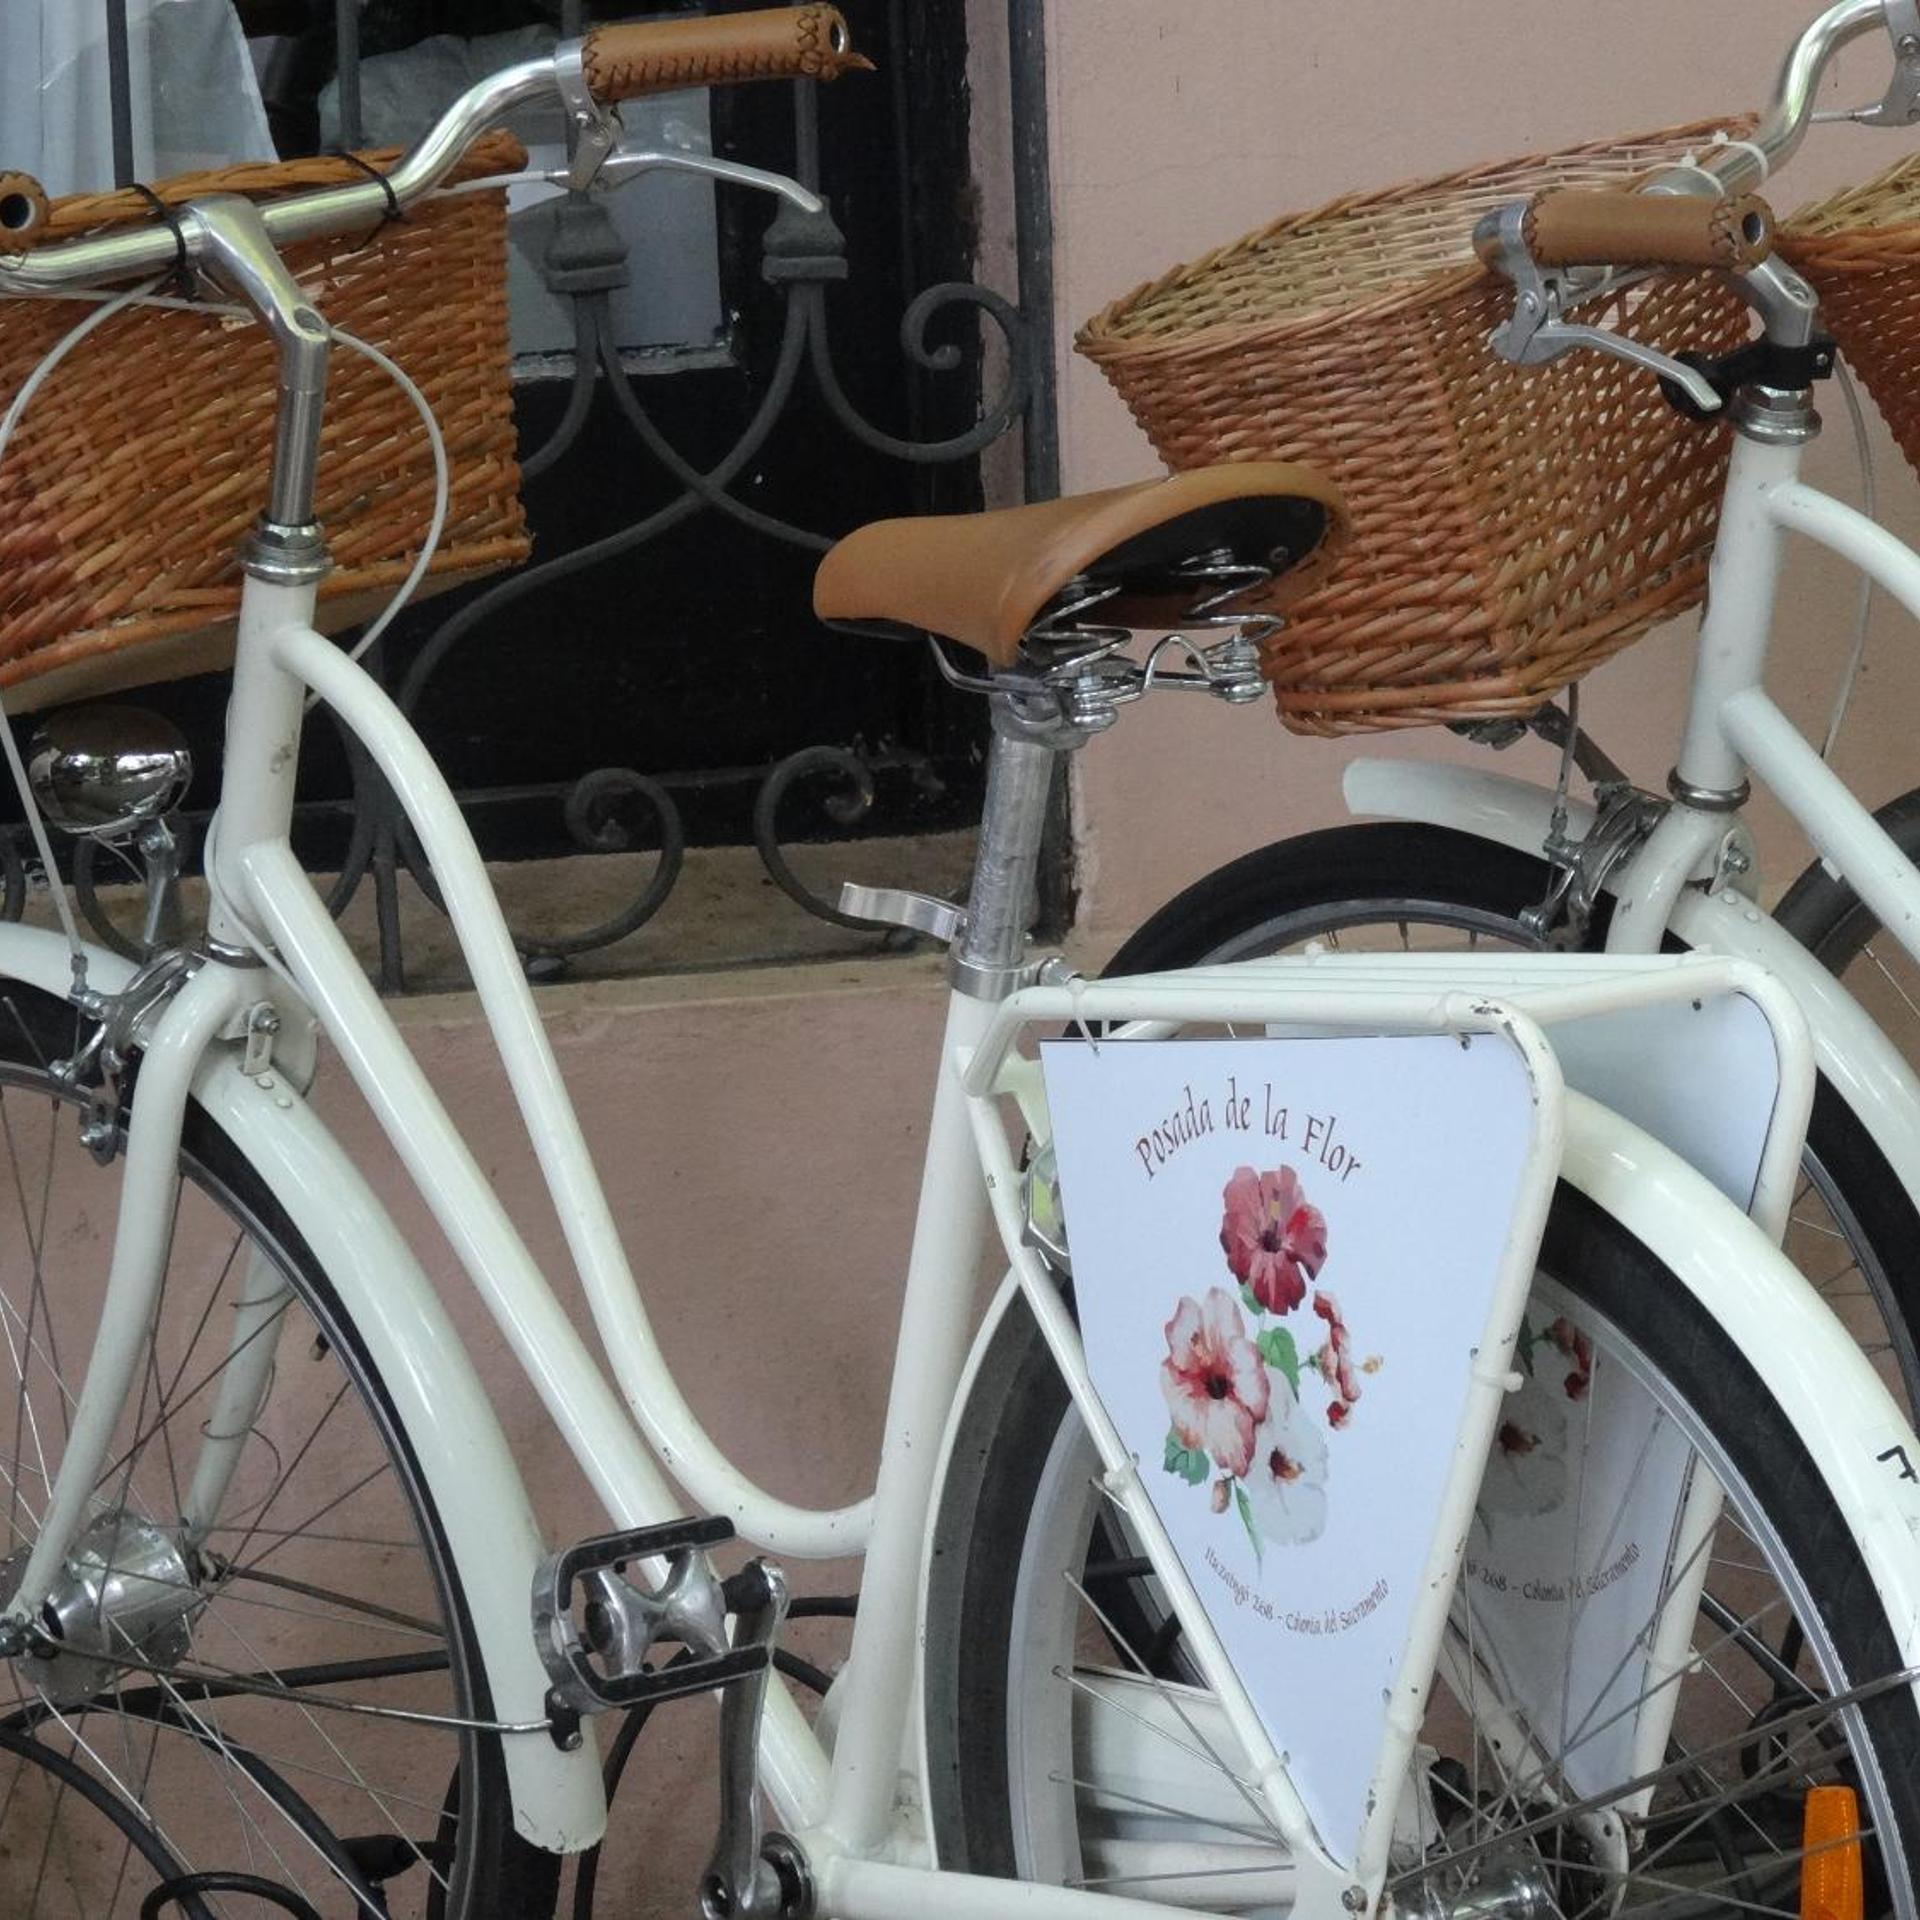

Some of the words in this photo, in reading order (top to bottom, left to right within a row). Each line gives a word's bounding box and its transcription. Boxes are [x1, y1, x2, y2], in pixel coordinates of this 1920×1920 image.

[1135, 1084, 1215, 1178] Posada
[1225, 1076, 1251, 1131] de
[1263, 1082, 1289, 1141] la
[1300, 1113, 1362, 1183] Flor
[1586, 1542, 1641, 1595] Sacramento
[1340, 1577, 1388, 1631] Sacramento
